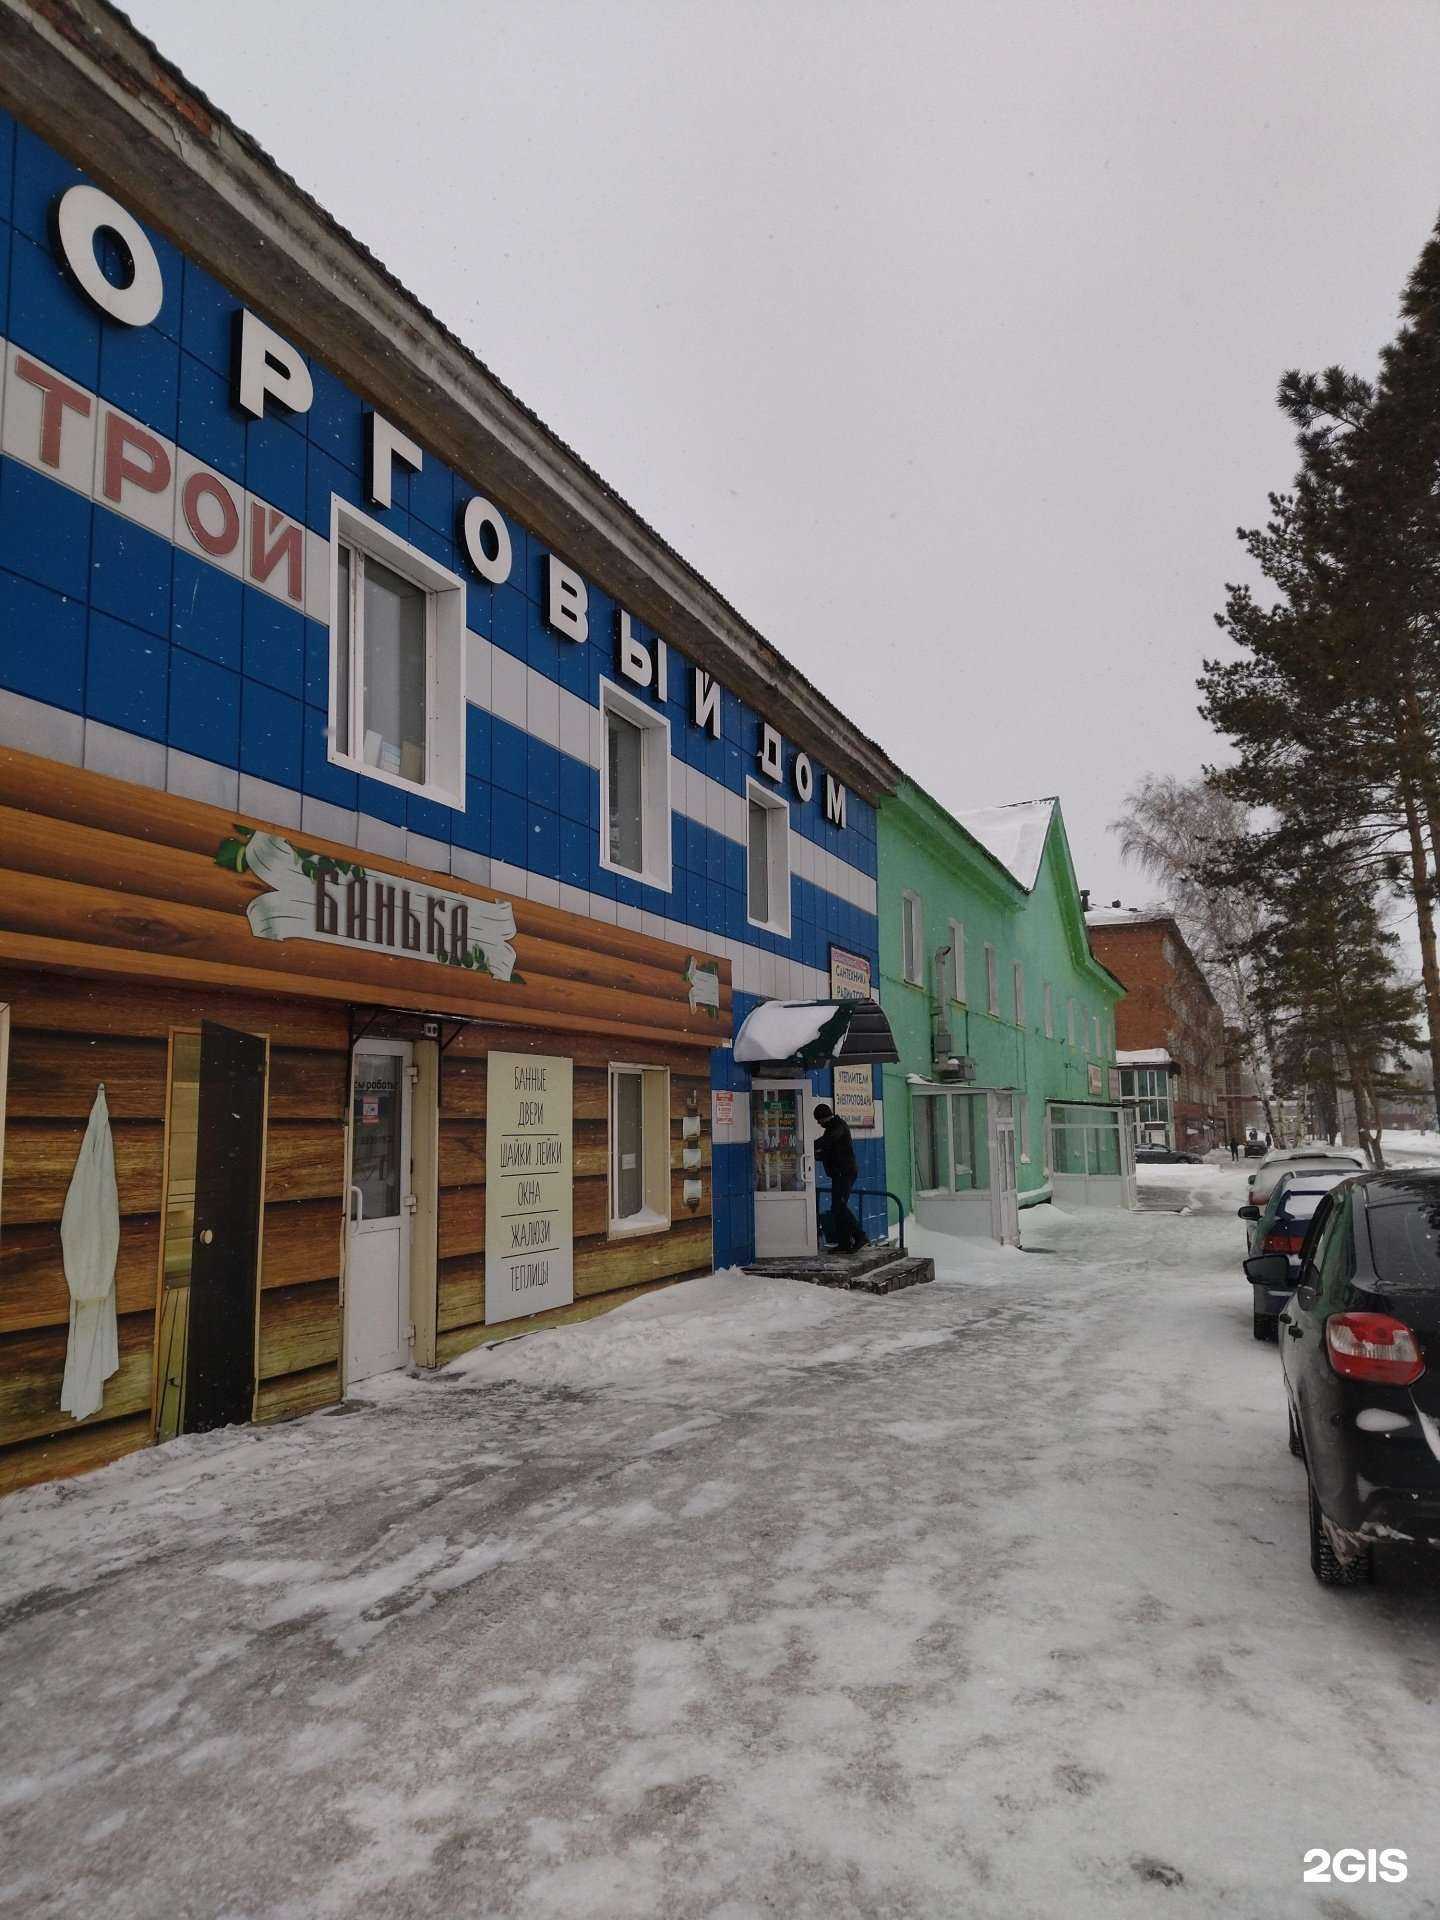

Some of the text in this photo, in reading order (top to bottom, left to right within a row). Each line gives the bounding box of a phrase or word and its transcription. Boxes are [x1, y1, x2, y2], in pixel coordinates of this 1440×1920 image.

[15, 354, 303, 602] ТРОЙ
[758, 721, 847, 829] ДОМ
[315, 866, 469, 959] БАНЬКА
[514, 1066, 548, 1092] БАННЫЕ
[518, 1101, 544, 1128] ДВЕРИ
[500, 1137, 562, 1168] ШАЙКИ ЛЕЙКИ
[517, 1180, 541, 1206] ОКНА
[511, 1219, 551, 1248] ЖАЛЮЗИ
[510, 1260, 549, 1292] ТЕПЛИЦЫ
